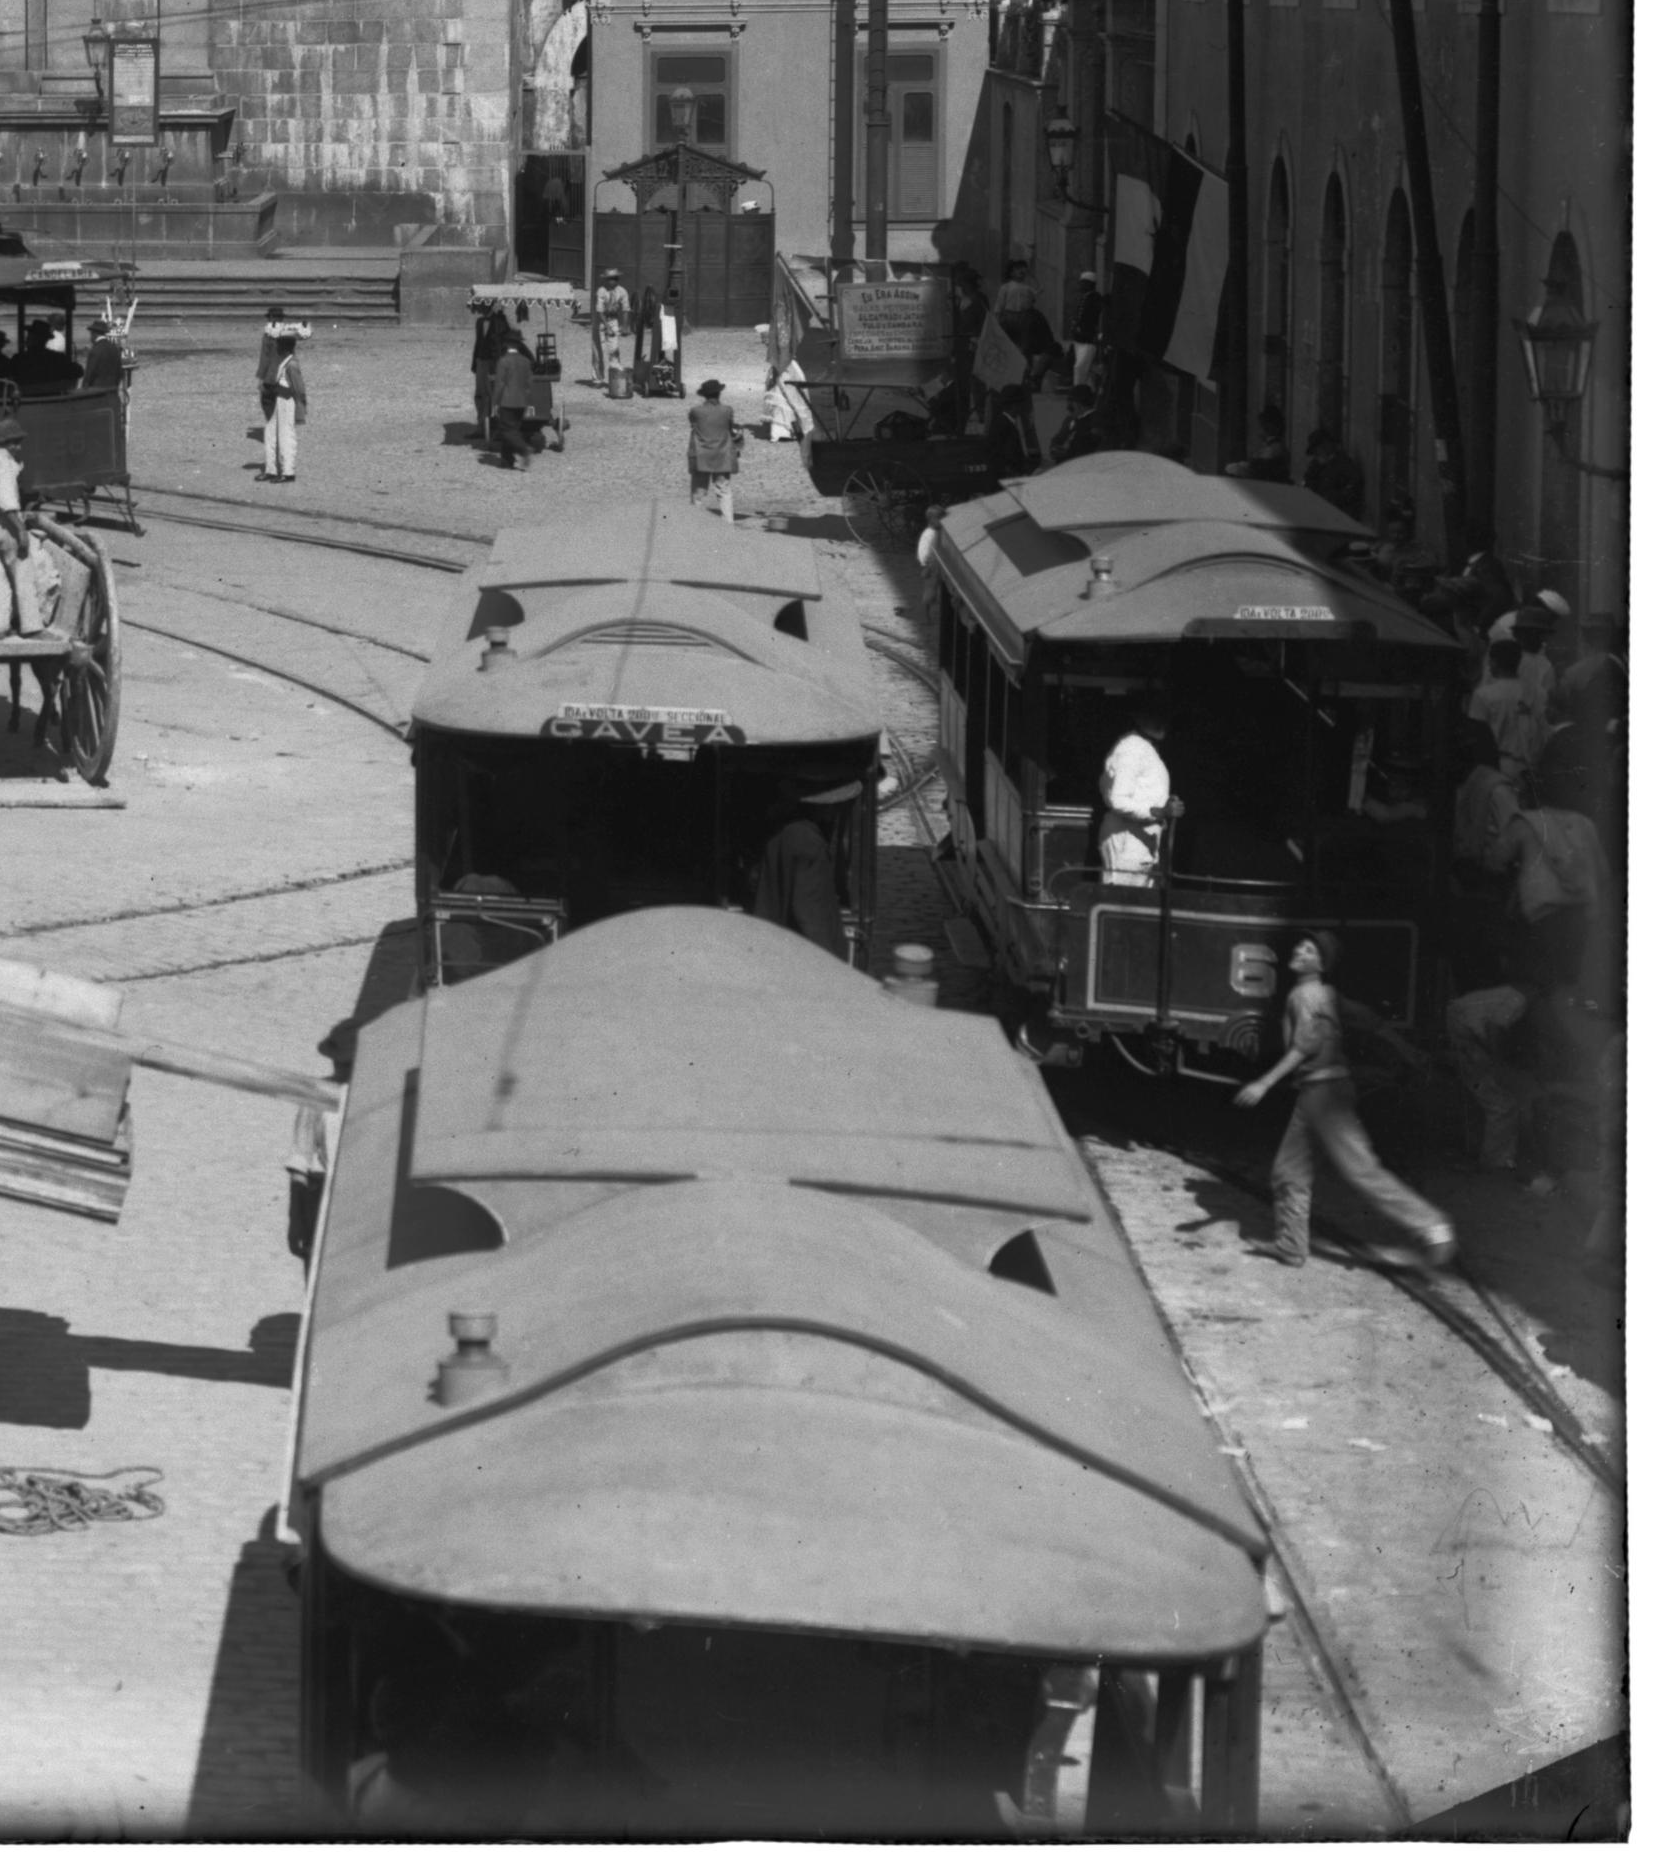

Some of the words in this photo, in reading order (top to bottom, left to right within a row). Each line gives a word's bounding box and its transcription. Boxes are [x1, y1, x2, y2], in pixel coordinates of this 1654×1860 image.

[588, 706, 624, 720] VOLTA
[550, 719, 734, 744] GAVEA
[1231, 943, 1278, 998] 6
